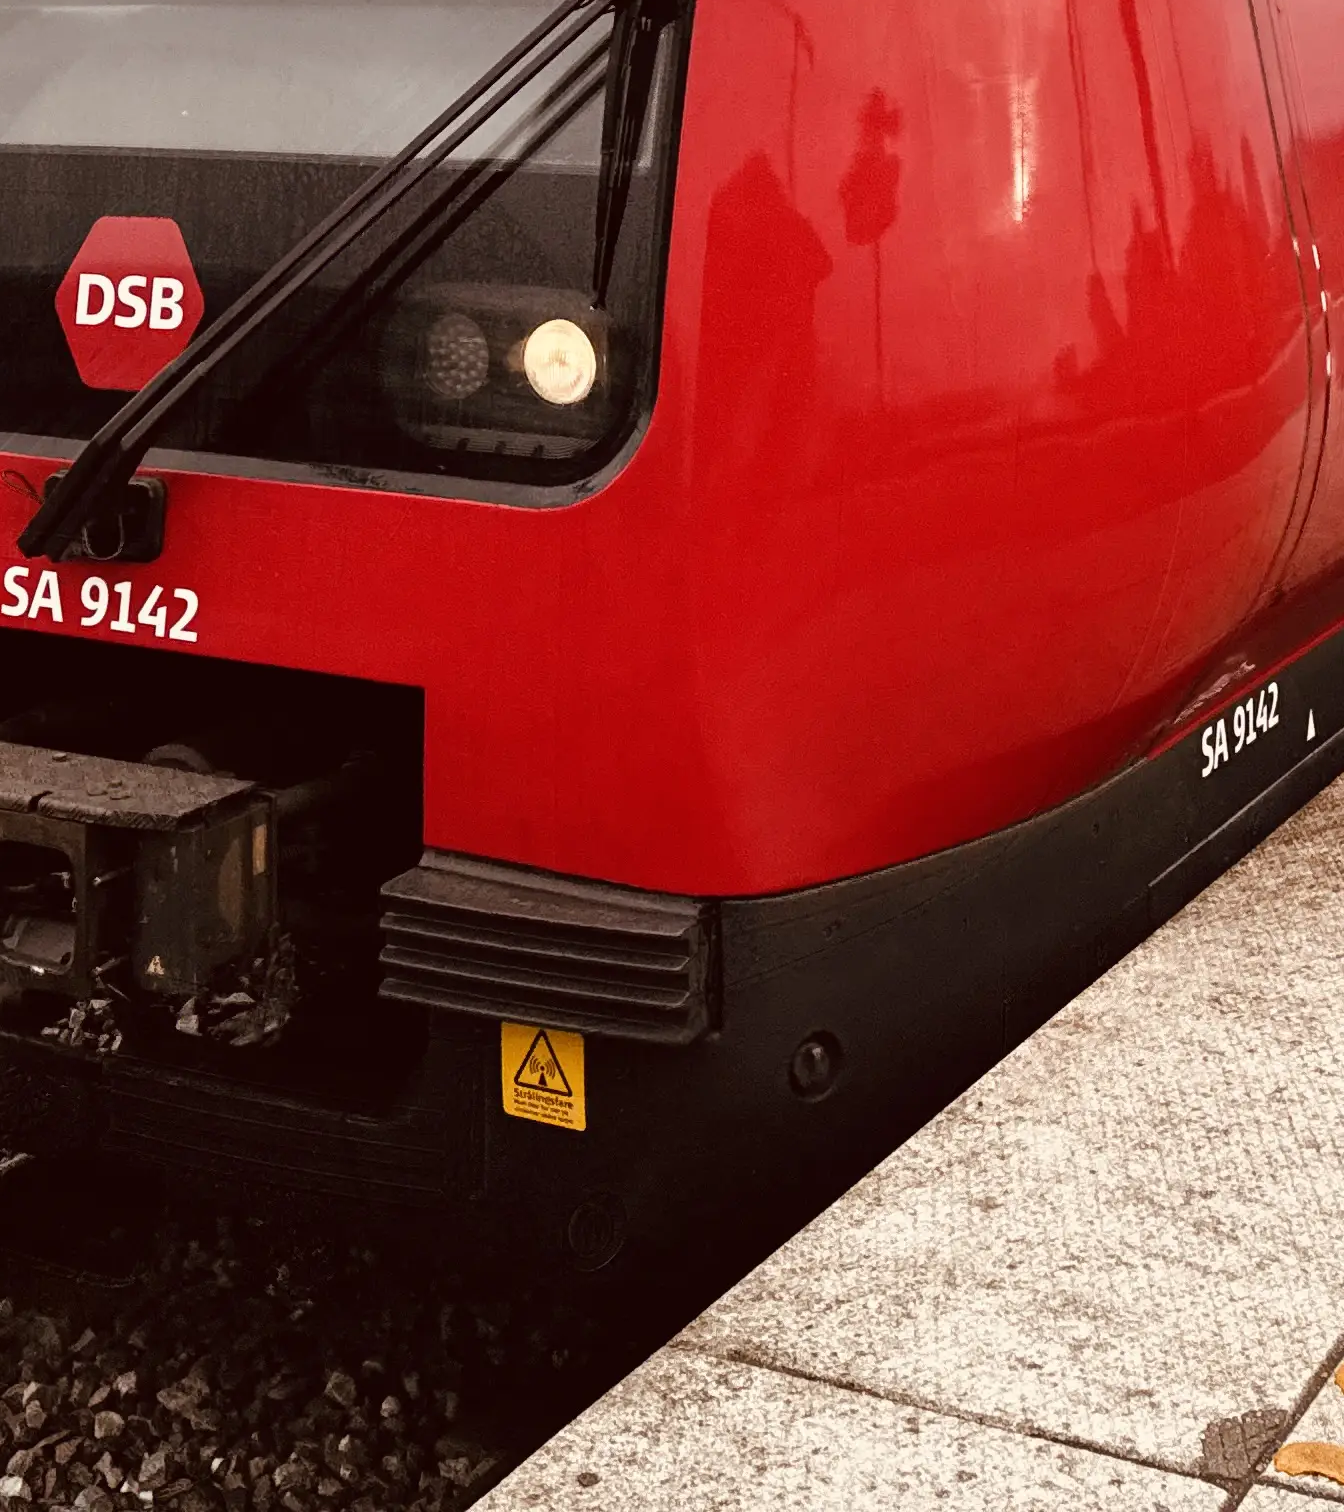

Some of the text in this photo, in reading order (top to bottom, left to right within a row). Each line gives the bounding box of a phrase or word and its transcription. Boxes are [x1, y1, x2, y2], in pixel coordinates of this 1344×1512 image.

[75, 273, 184, 330] DSB
[0, 565, 199, 643] SA 9142
[1201, 681, 1279, 778] SA 9142
